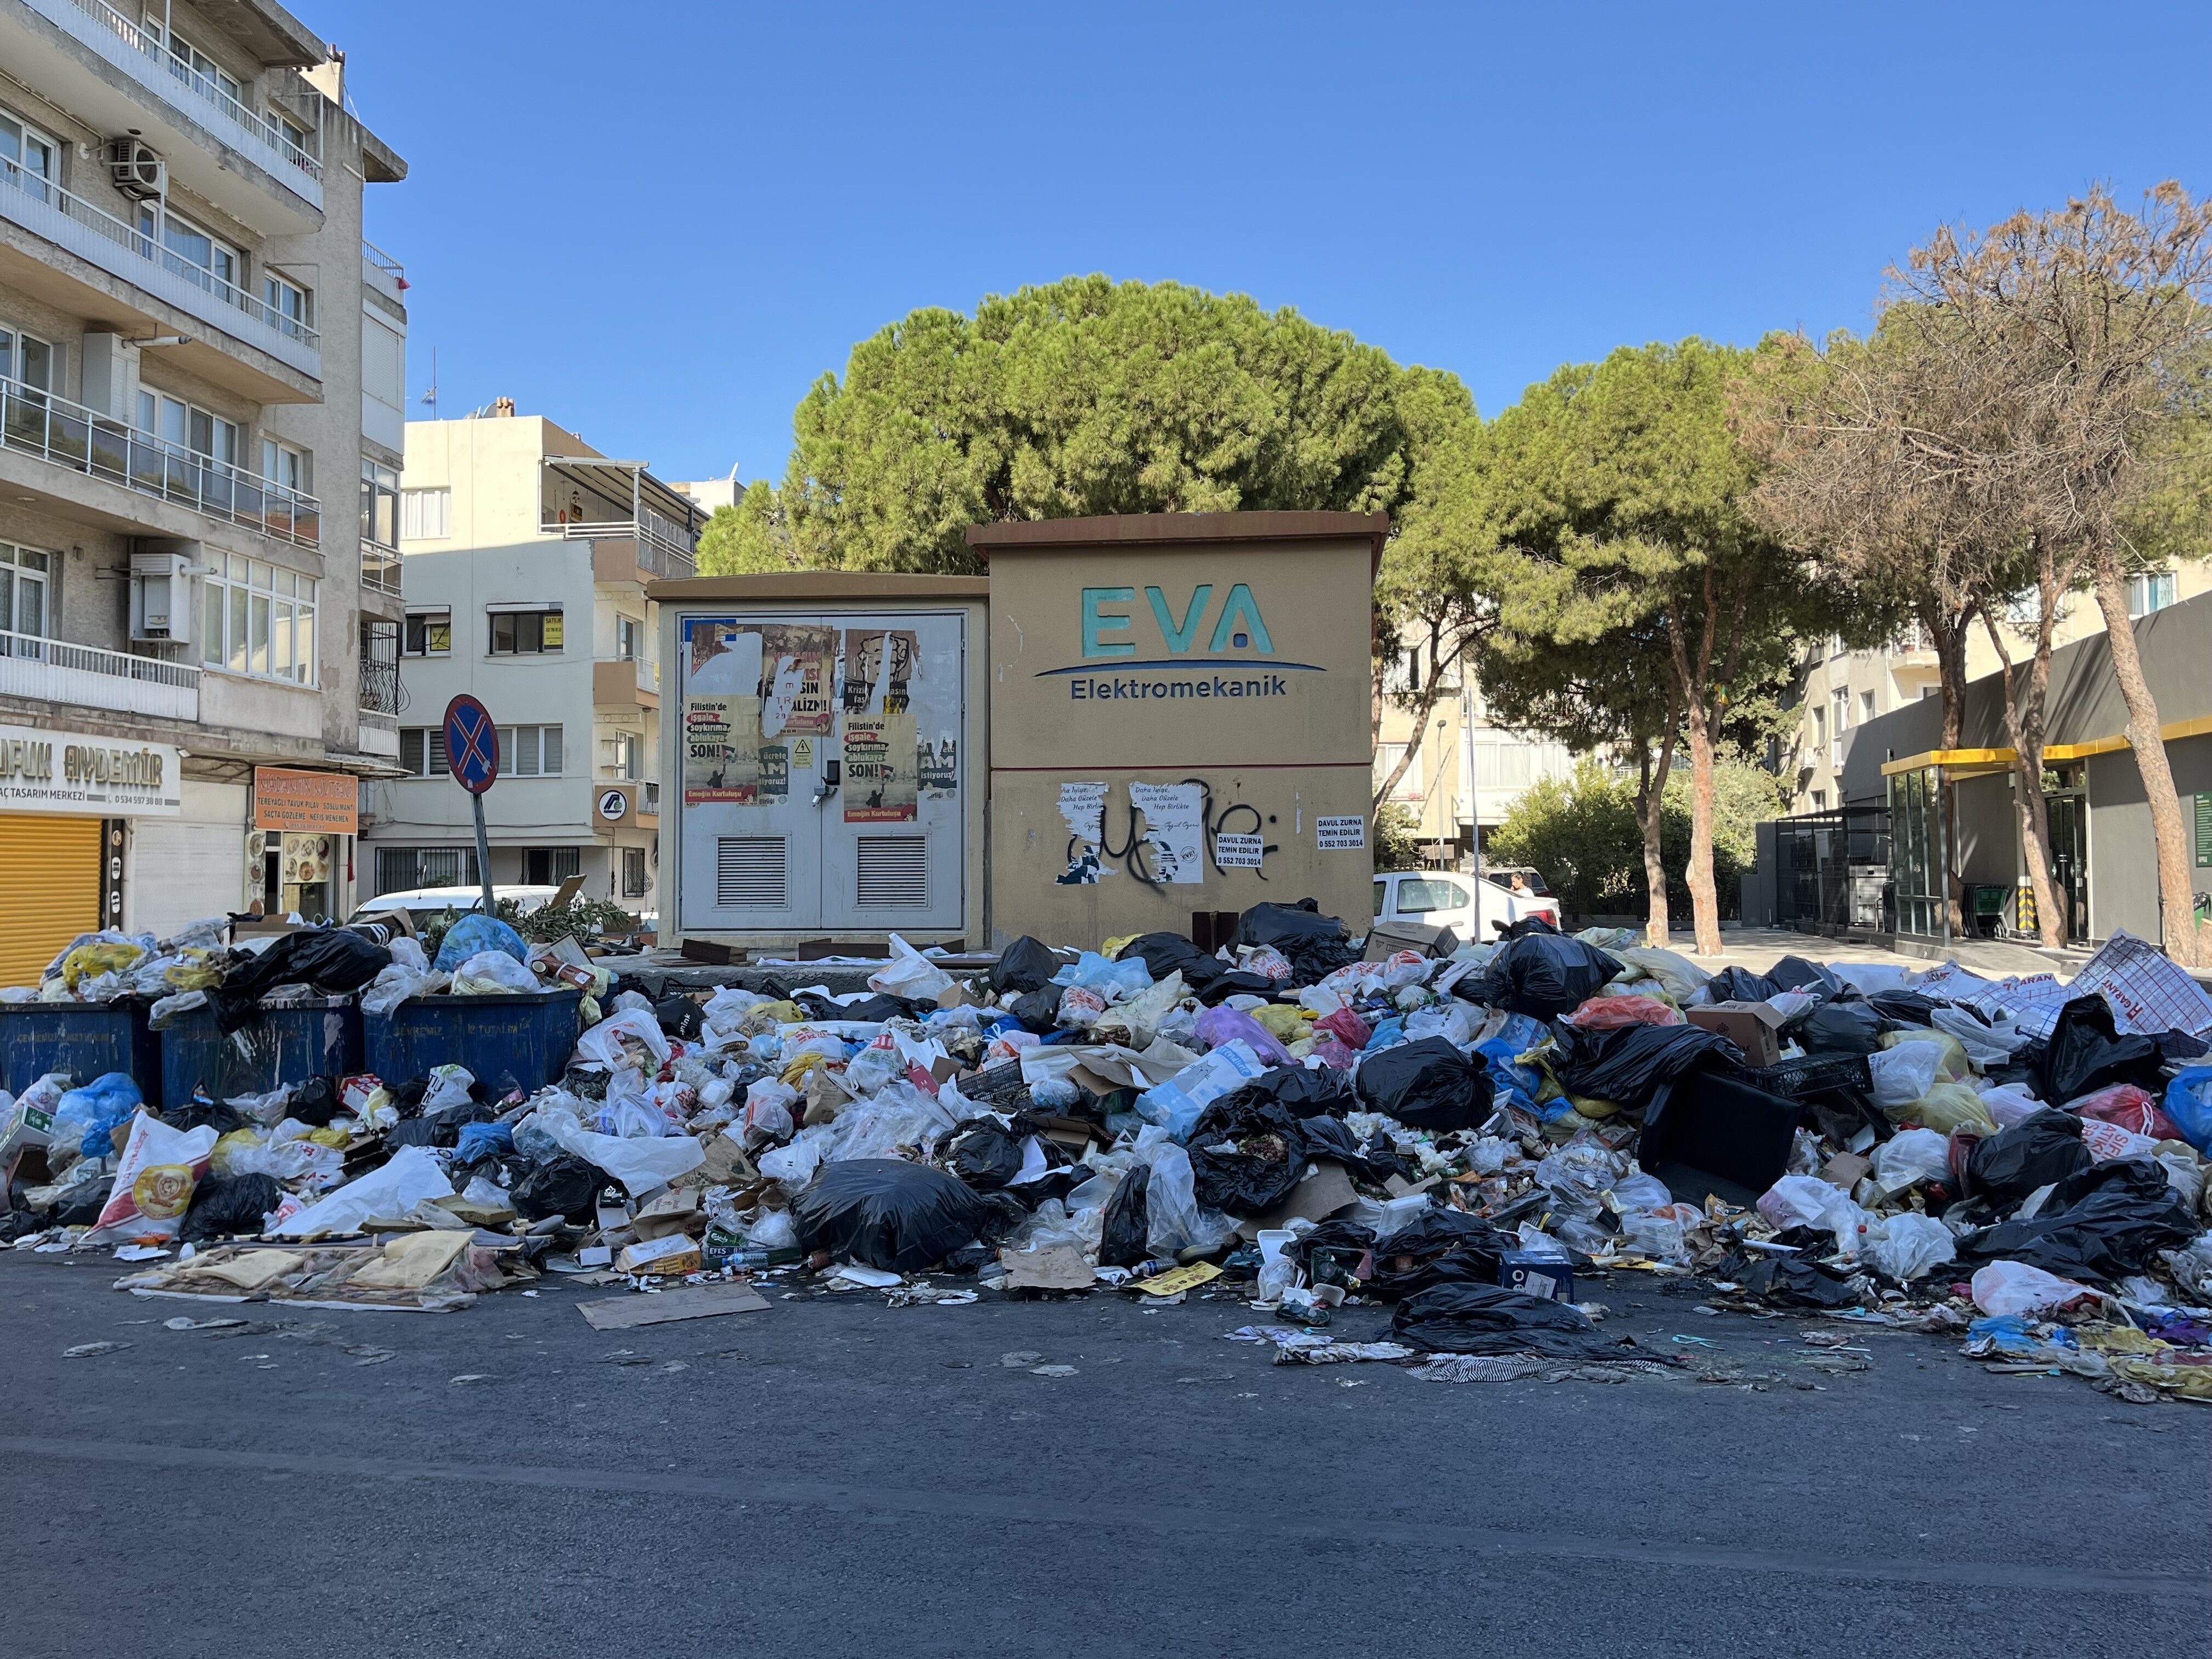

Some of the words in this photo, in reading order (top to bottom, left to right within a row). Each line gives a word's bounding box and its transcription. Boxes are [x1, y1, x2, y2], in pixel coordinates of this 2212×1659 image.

[1082, 583, 1275, 657] EVA
[1071, 675, 1286, 699] Elektromekanik
[691, 703, 727, 711] Filistin'de
[848, 722, 884, 730] Filistin'de
[690, 744, 720, 758] SON!
[64, 745, 163, 787] AYDEMİR
[849, 764, 878, 777] SON!
[759, 777, 786, 786] tiyoruz!
[11, 788, 48, 799] TASARIM
[50, 790, 85, 801] MERKEZİ
